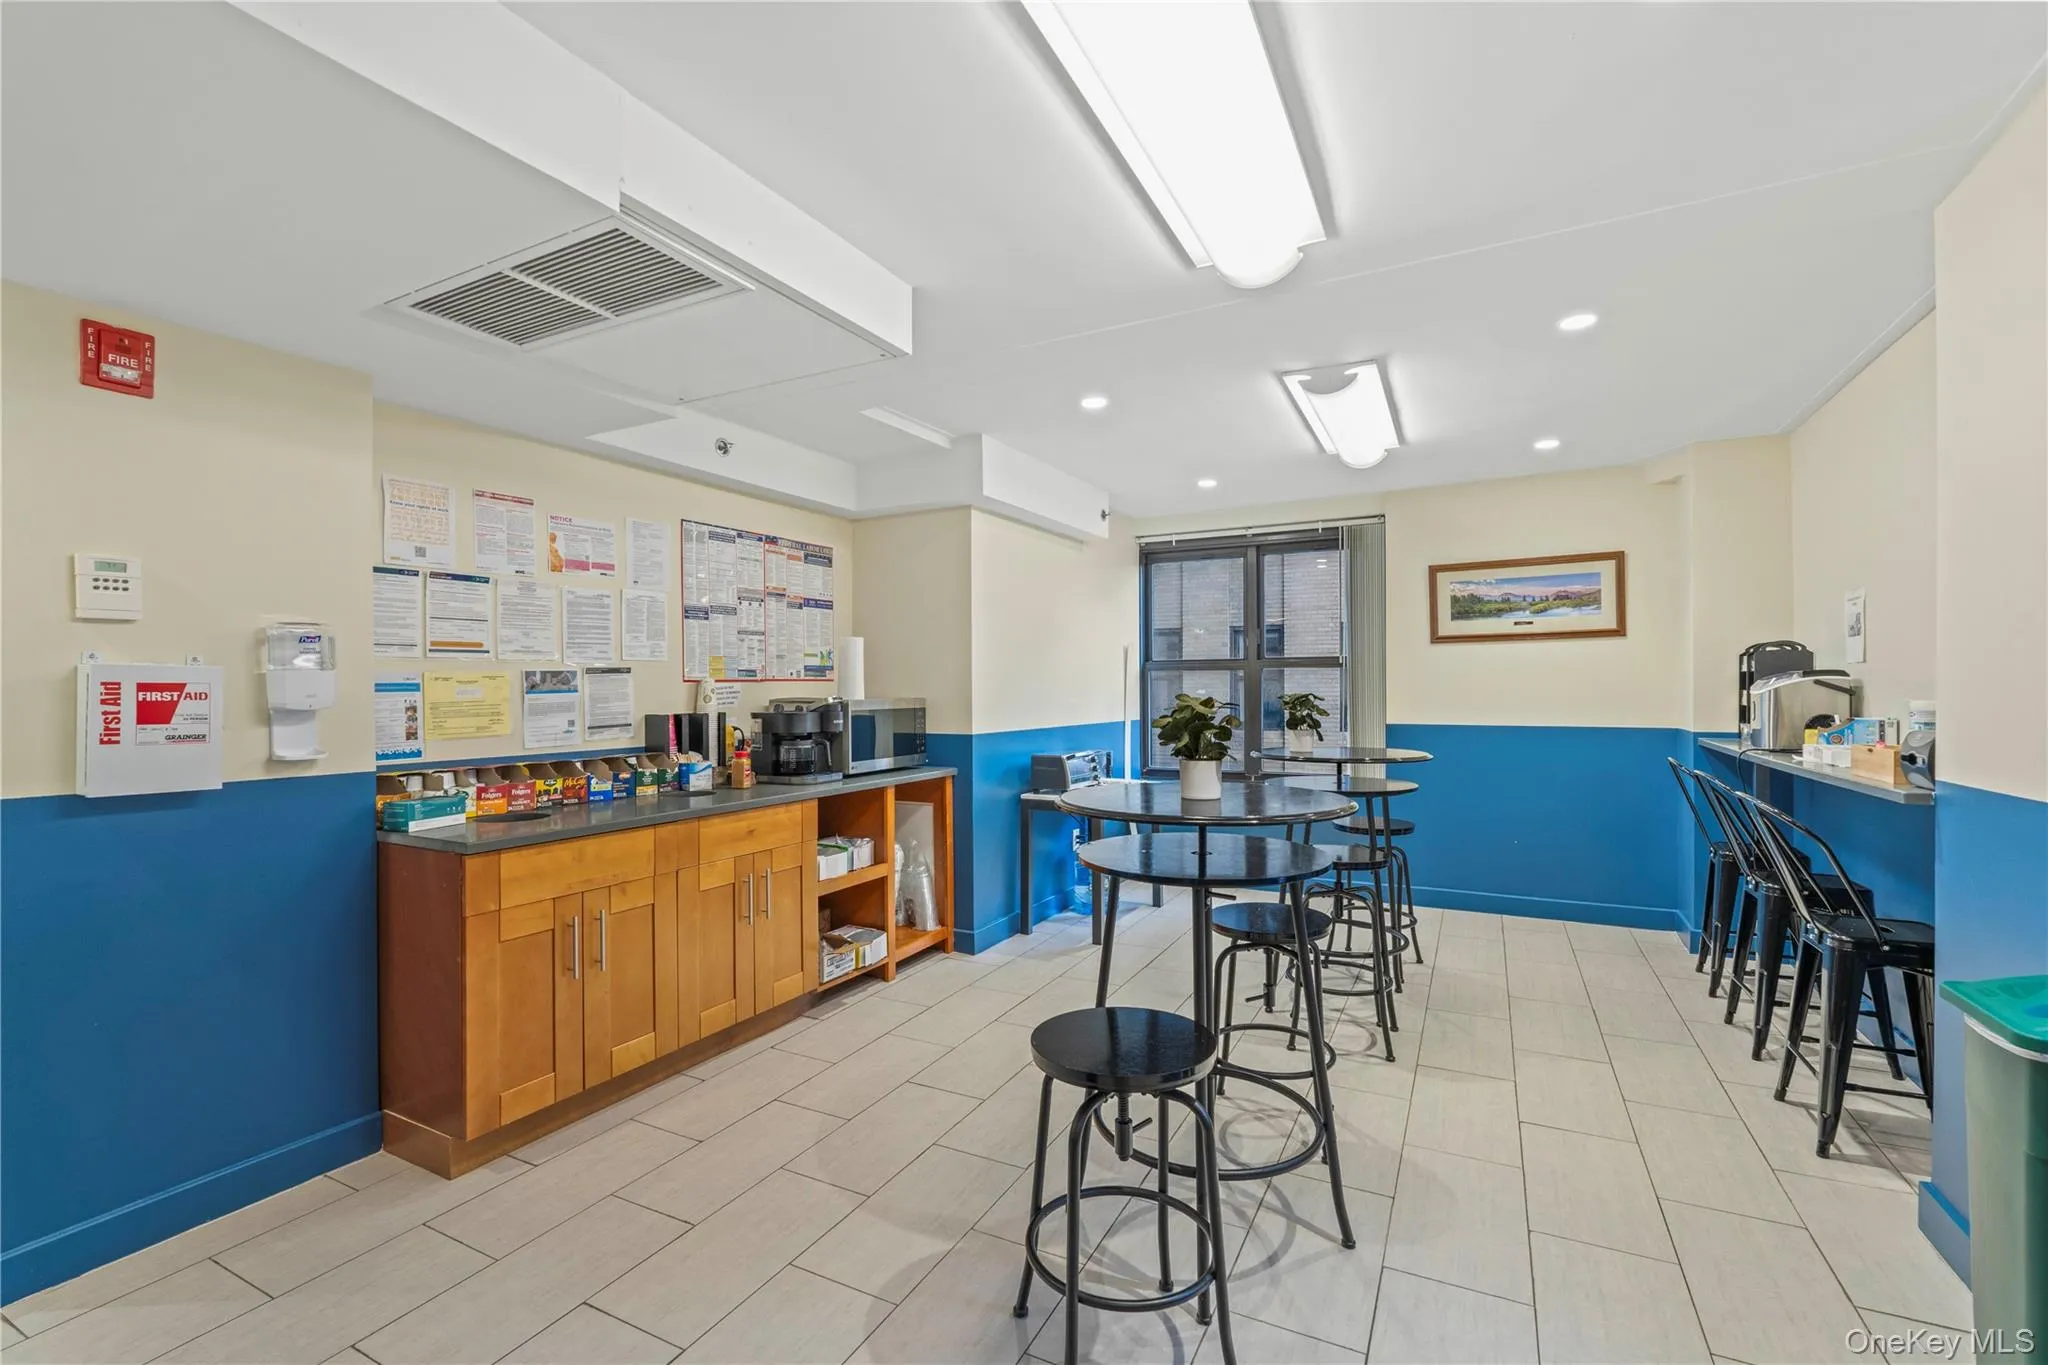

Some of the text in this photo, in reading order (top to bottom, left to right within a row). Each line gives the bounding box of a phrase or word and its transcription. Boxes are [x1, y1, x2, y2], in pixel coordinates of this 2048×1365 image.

[108, 353, 139, 369] FIRE
[549, 514, 573, 523] NOTICE
[137, 691, 209, 702] FIRST AID
[98, 681, 122, 746] First Aid
[164, 733, 207, 742] GRAINGER
[511, 788, 531, 796] Folgers
